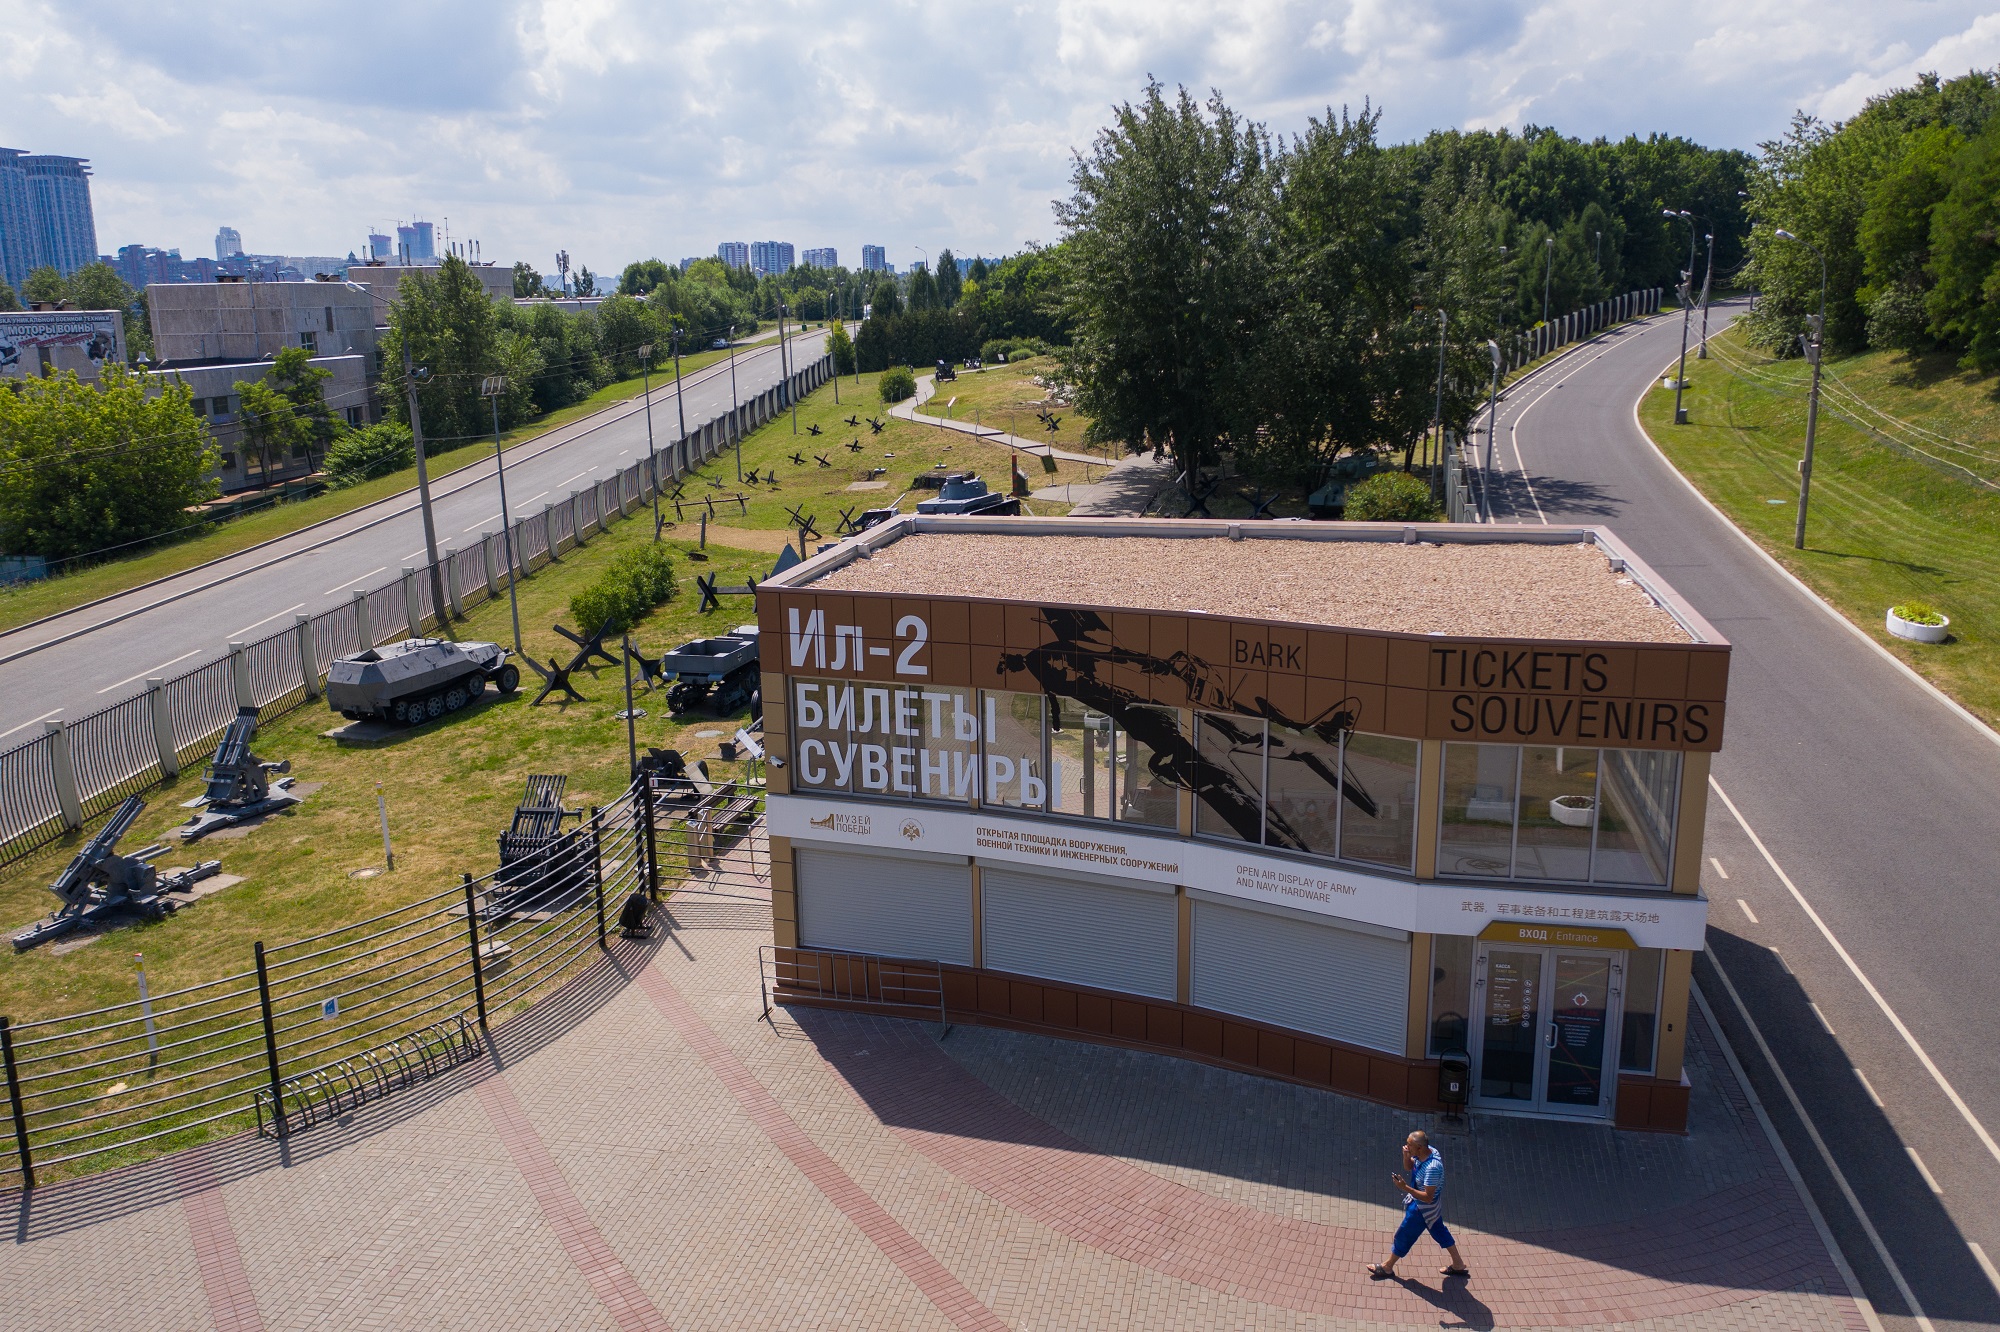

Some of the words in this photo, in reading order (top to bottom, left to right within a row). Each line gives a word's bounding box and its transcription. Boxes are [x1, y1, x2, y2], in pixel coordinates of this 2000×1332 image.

[8, 324, 56, 336] МОТОРЫ
[57, 322, 94, 334] ВОЙНЫ
[788, 607, 929, 676] Ил-2
[1235, 639, 1302, 670] BARK
[1432, 648, 1608, 692] TICKETS
[797, 682, 996, 744] БИЛЕТЫ
[1451, 695, 1709, 743] SOUVENIRS
[800, 739, 1062, 808] СУВЕНИРЫ
[836, 814, 871, 825] МУЗЕЙ
[836, 823, 871, 835] ПОБЕДЫ
[976, 827, 1019, 841] ОТКРЫТАЯ
[1021, 833, 1067, 847] ПЛОЩАДКА
[1069, 840, 1128, 856] ВООРУЖЕНИЯ,
[976, 838, 1013, 850] ВОЕННОЙ
[1014, 843, 1051, 856] ТЕХНИКИ
[1052, 848, 1058, 857] И
[1060, 850, 1118, 865] ИНЖЕНЕРНЫХ
[1120, 858, 1179, 873] СООРУЖЕНИЙ
[1236, 865, 1259, 877] OPEN
[1261, 869, 1276, 880] AIR
[1278, 873, 1314, 888] DISPLAY
[1317, 880, 1328, 890] OF
[1330, 883, 1357, 895] ARMY
[1236, 877, 1254, 888] AND
[1256, 880, 1279, 892] NAVY
[1281, 885, 1331, 903] HARDWARE
[1519, 928, 1547, 941] ВХОД
[1556, 931, 1598, 943] Entrance
